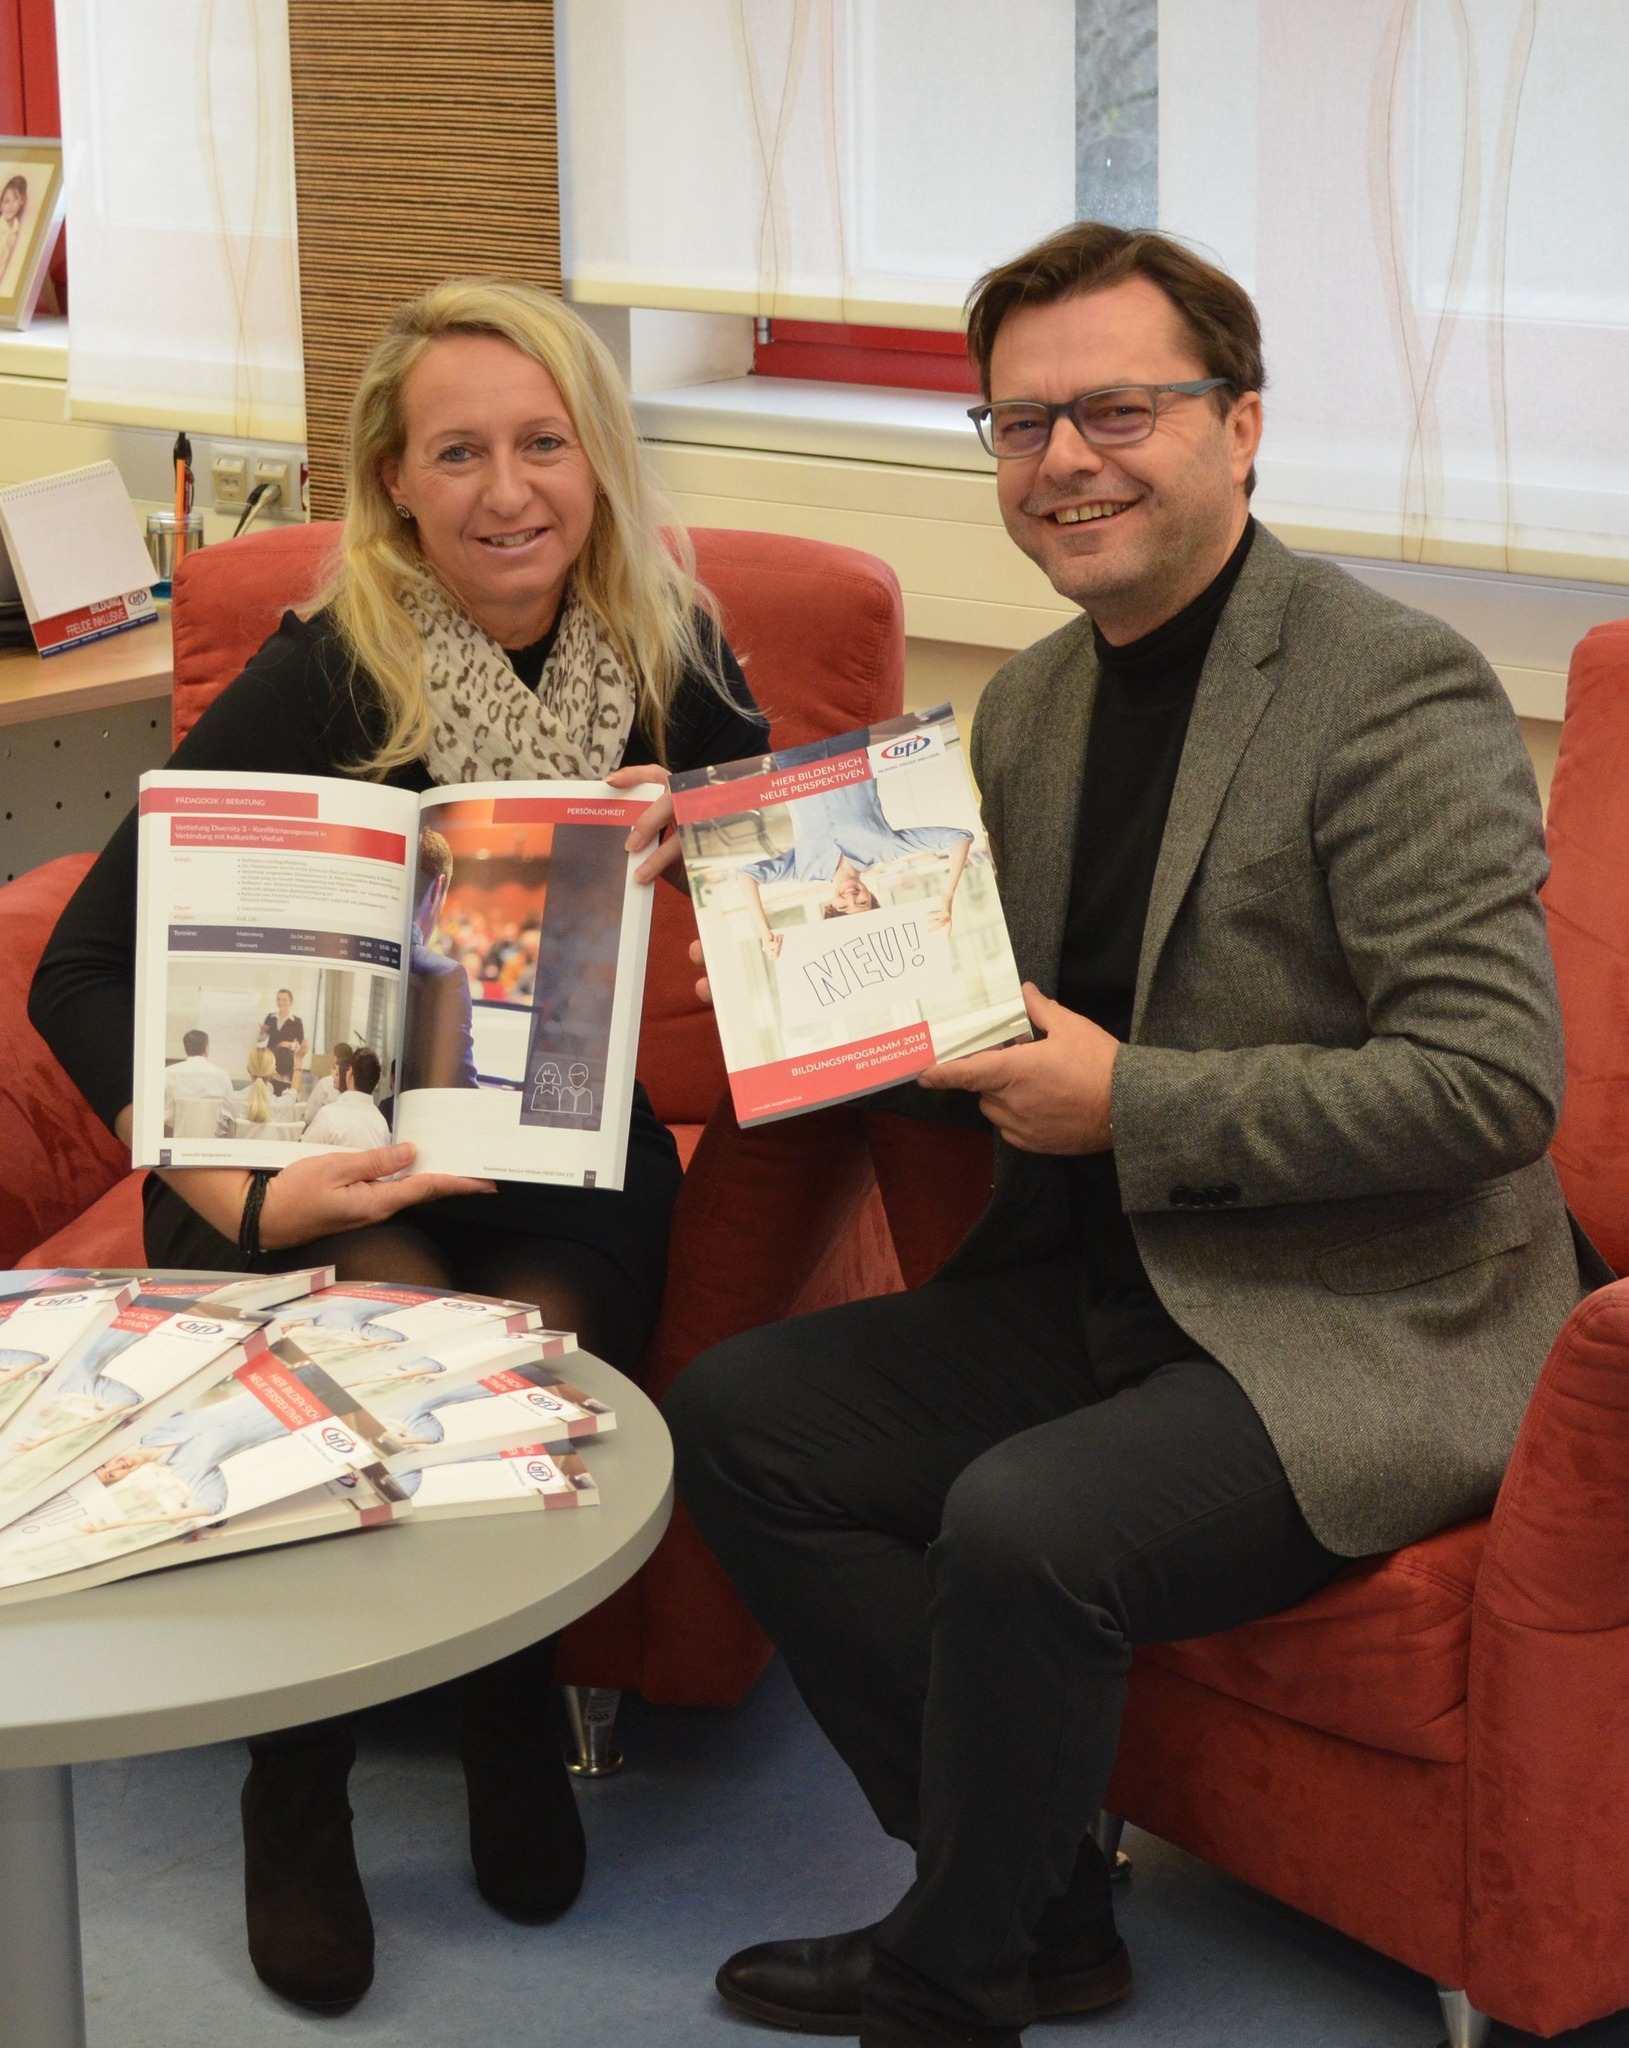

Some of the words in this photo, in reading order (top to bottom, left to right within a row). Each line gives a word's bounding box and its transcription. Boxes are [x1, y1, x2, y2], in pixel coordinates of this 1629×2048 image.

[66, 619, 93, 637] FREUDE
[92, 608, 127, 629] INKLUSIVE
[759, 787, 789, 802] NEUE
[790, 767, 865, 795] PERSPEKTIVEN
[771, 774, 796, 788] HIER
[797, 764, 836, 782] BILDEN
[838, 757, 863, 773] SICH
[175, 796, 220, 806] PÄDAGOGIK
[225, 797, 266, 807] BERATUNG
[567, 806, 626, 817] PERSÖNLICHKEIT
[175, 824, 210, 833] Vertiefung
[211, 824, 241, 834] Diversity
[252, 826, 319, 838] Konfliktmanagement
[175, 832, 213, 842] Verbindung
[260, 835, 284, 843] Vielfalt
[803, 922, 925, 1007] NEU!
[791, 1039, 901, 1077] BILDUNGSPROGRAMM
[903, 1031, 927, 1046] 2018
[855, 1061, 869, 1071] BFI
[870, 1042, 929, 1067] BURGENLAND
[249, 1373, 268, 1390] NEUE
[264, 1386, 305, 1426] PERSPEKTIVEN
[269, 1373, 287, 1387] HIER
[282, 1383, 307, 1409] BILDEN
[301, 1404, 321, 1419] SICH
